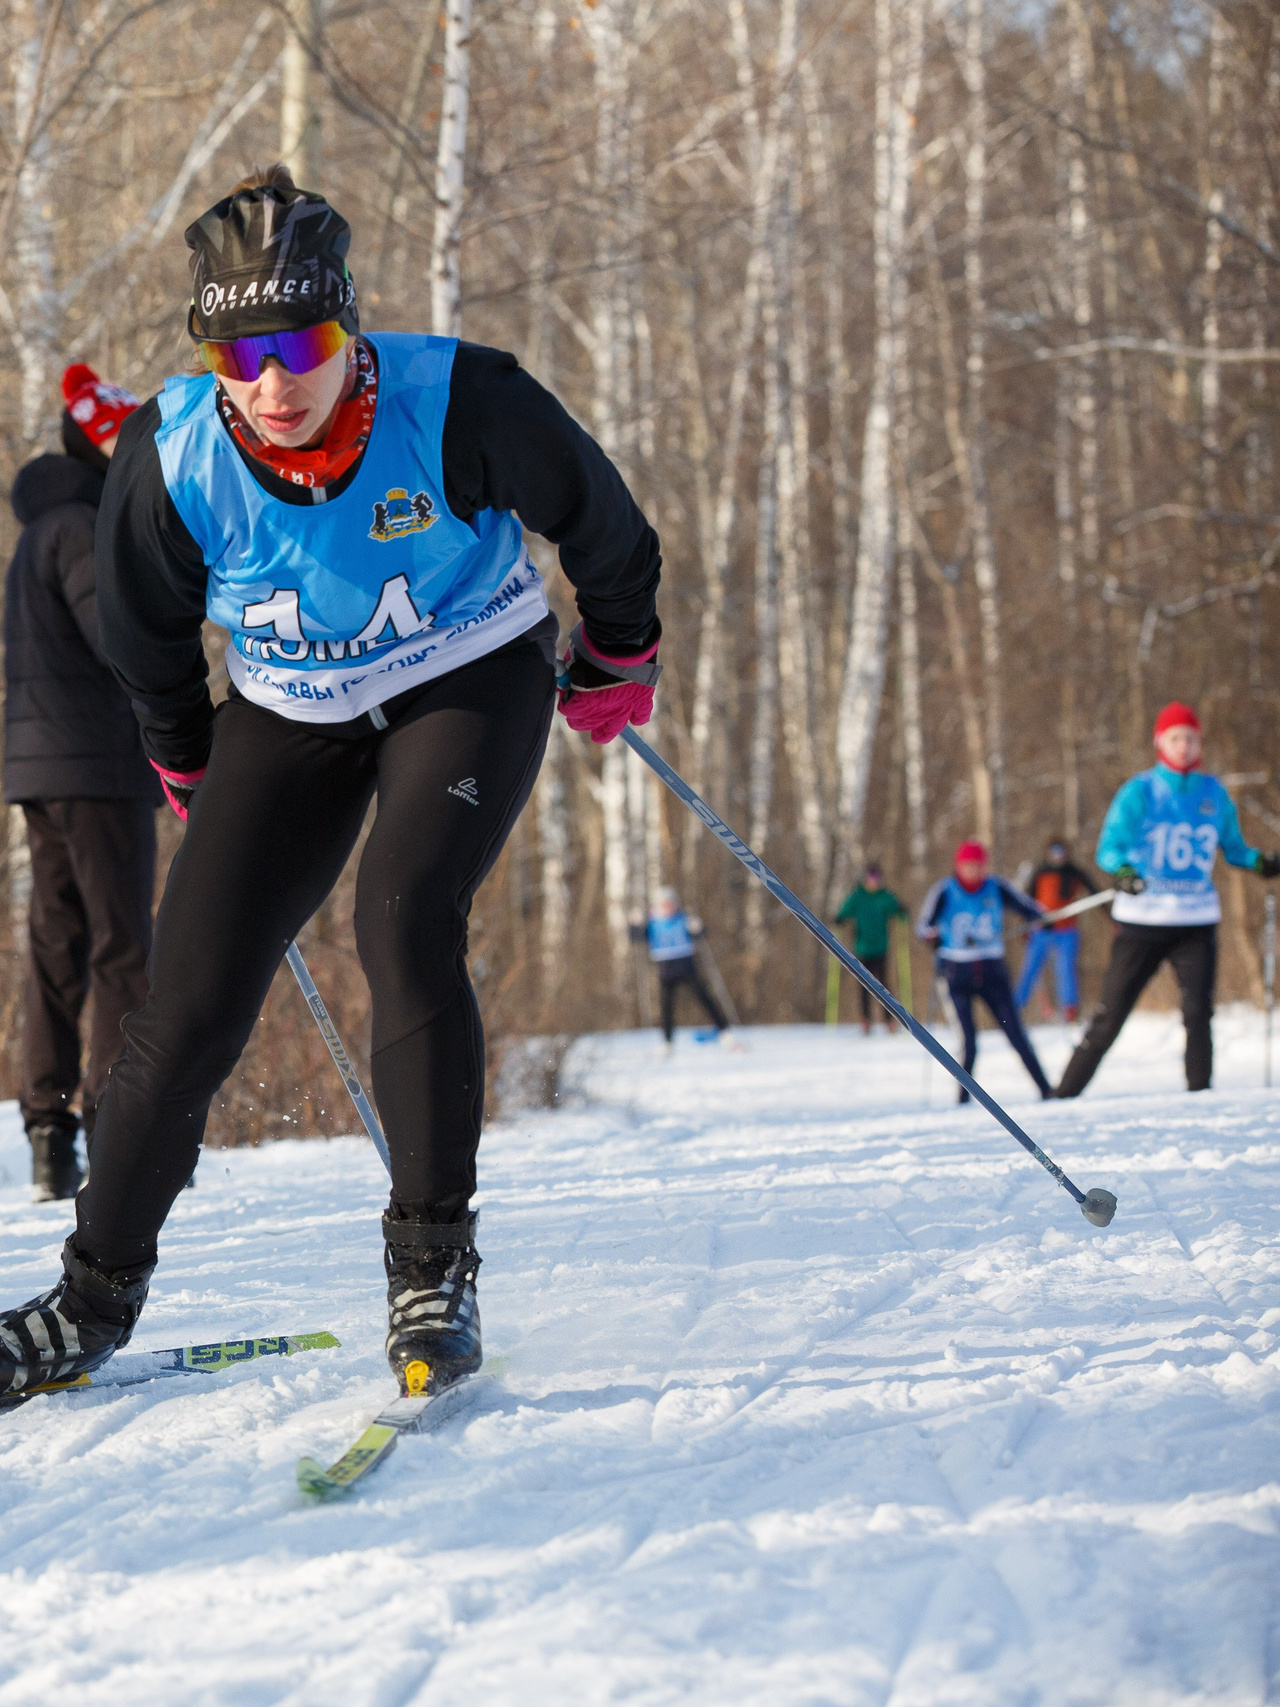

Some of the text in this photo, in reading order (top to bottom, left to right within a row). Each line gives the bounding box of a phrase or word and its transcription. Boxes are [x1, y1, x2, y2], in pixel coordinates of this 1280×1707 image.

[201, 279, 312, 316] BALANCE
[220, 294, 293, 312] RUNNING
[1144, 820, 1219, 873] 163
